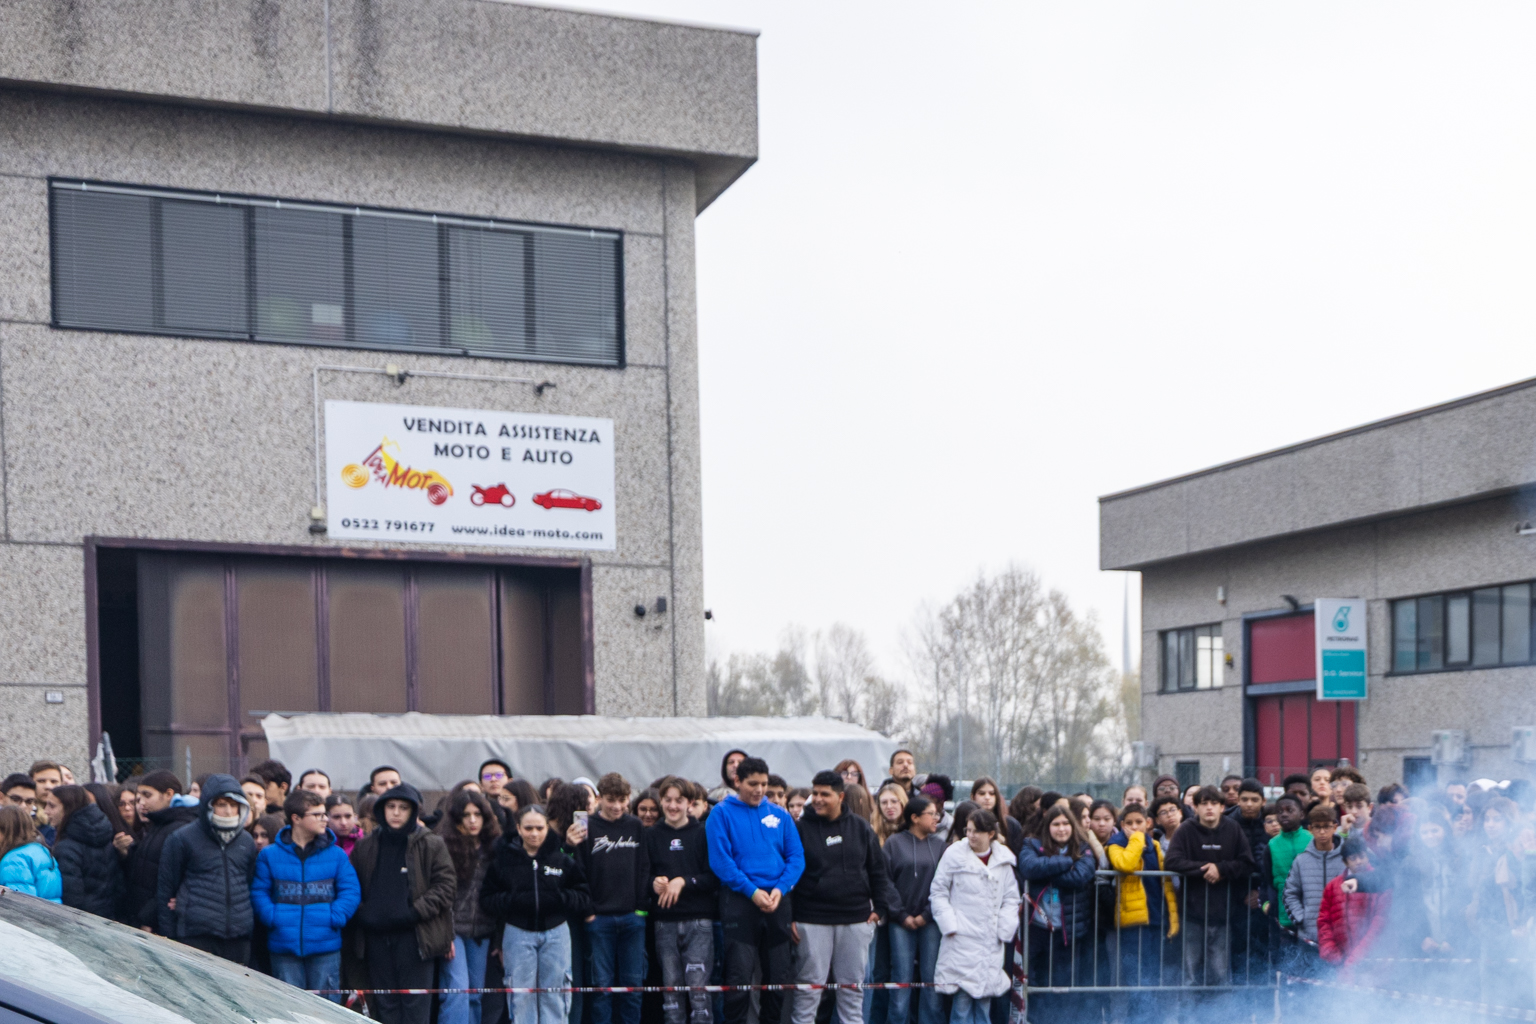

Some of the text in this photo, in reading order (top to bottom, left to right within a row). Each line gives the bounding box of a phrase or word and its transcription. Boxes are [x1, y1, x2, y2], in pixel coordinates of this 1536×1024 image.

[403, 417, 601, 443] VENDITA ASSISTENZA
[434, 442, 573, 465] MOTO E AUTO
[341, 518, 435, 532] 0522 791677
[451, 524, 603, 540] www.idea-moto.com
